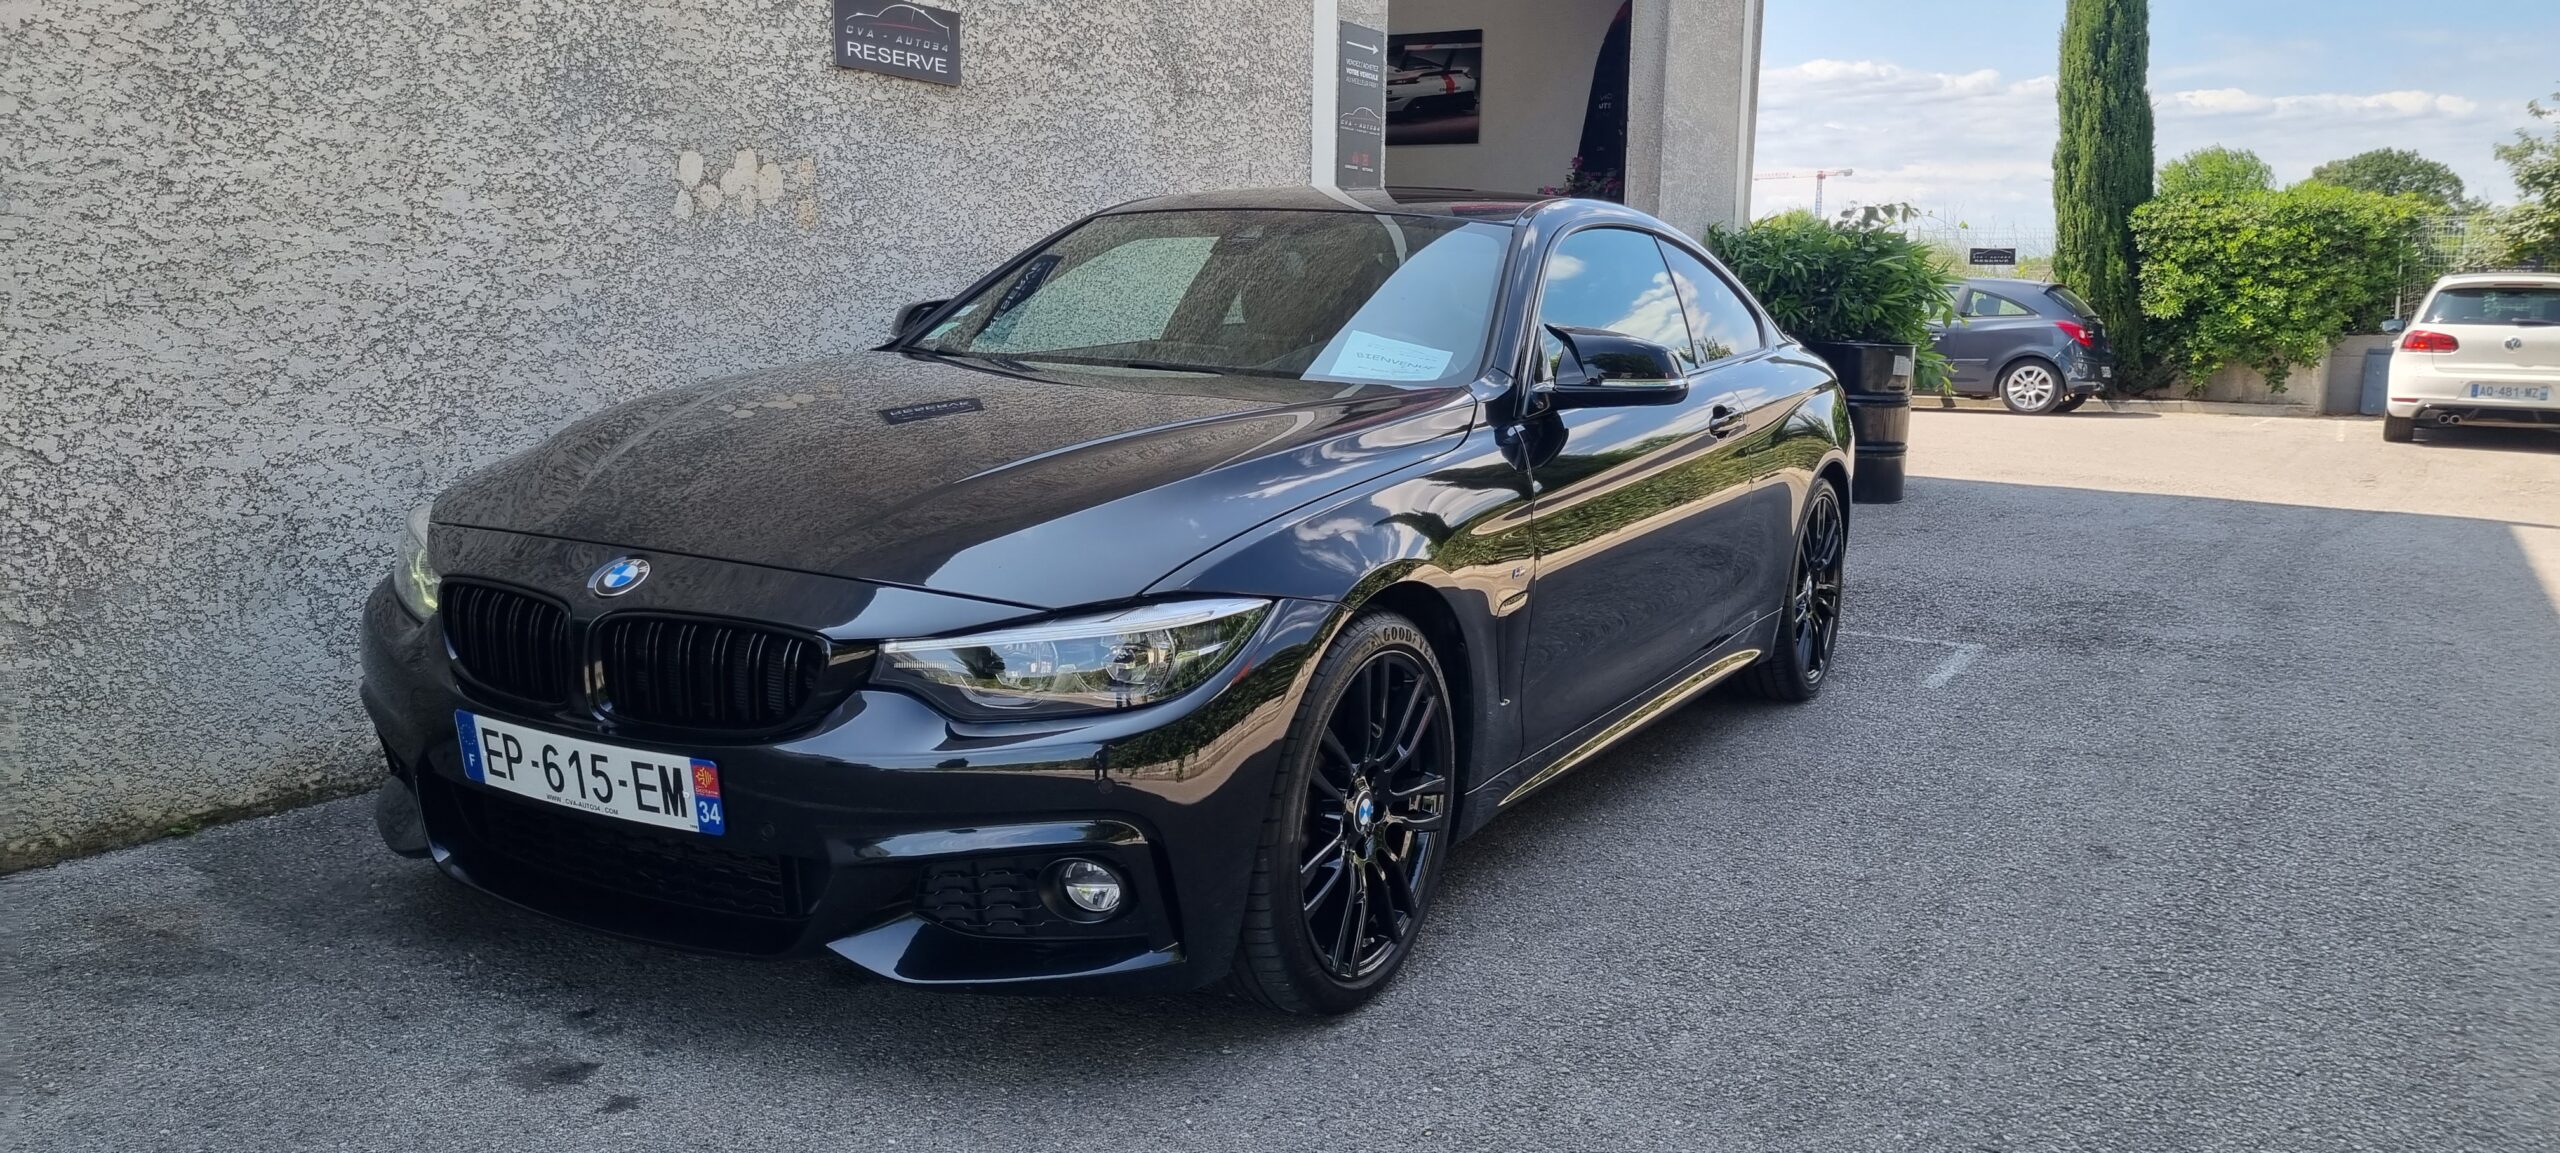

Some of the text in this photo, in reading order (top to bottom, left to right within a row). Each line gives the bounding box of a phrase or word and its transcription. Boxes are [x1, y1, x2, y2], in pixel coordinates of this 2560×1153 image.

[845, 24, 874, 39] CVA
[896, 35, 948, 52] AUTO34
[846, 40, 949, 74] RESERVE
[468, 752, 476, 768] F
[480, 726, 688, 819] EP-615-EM
[698, 800, 721, 825] 34
